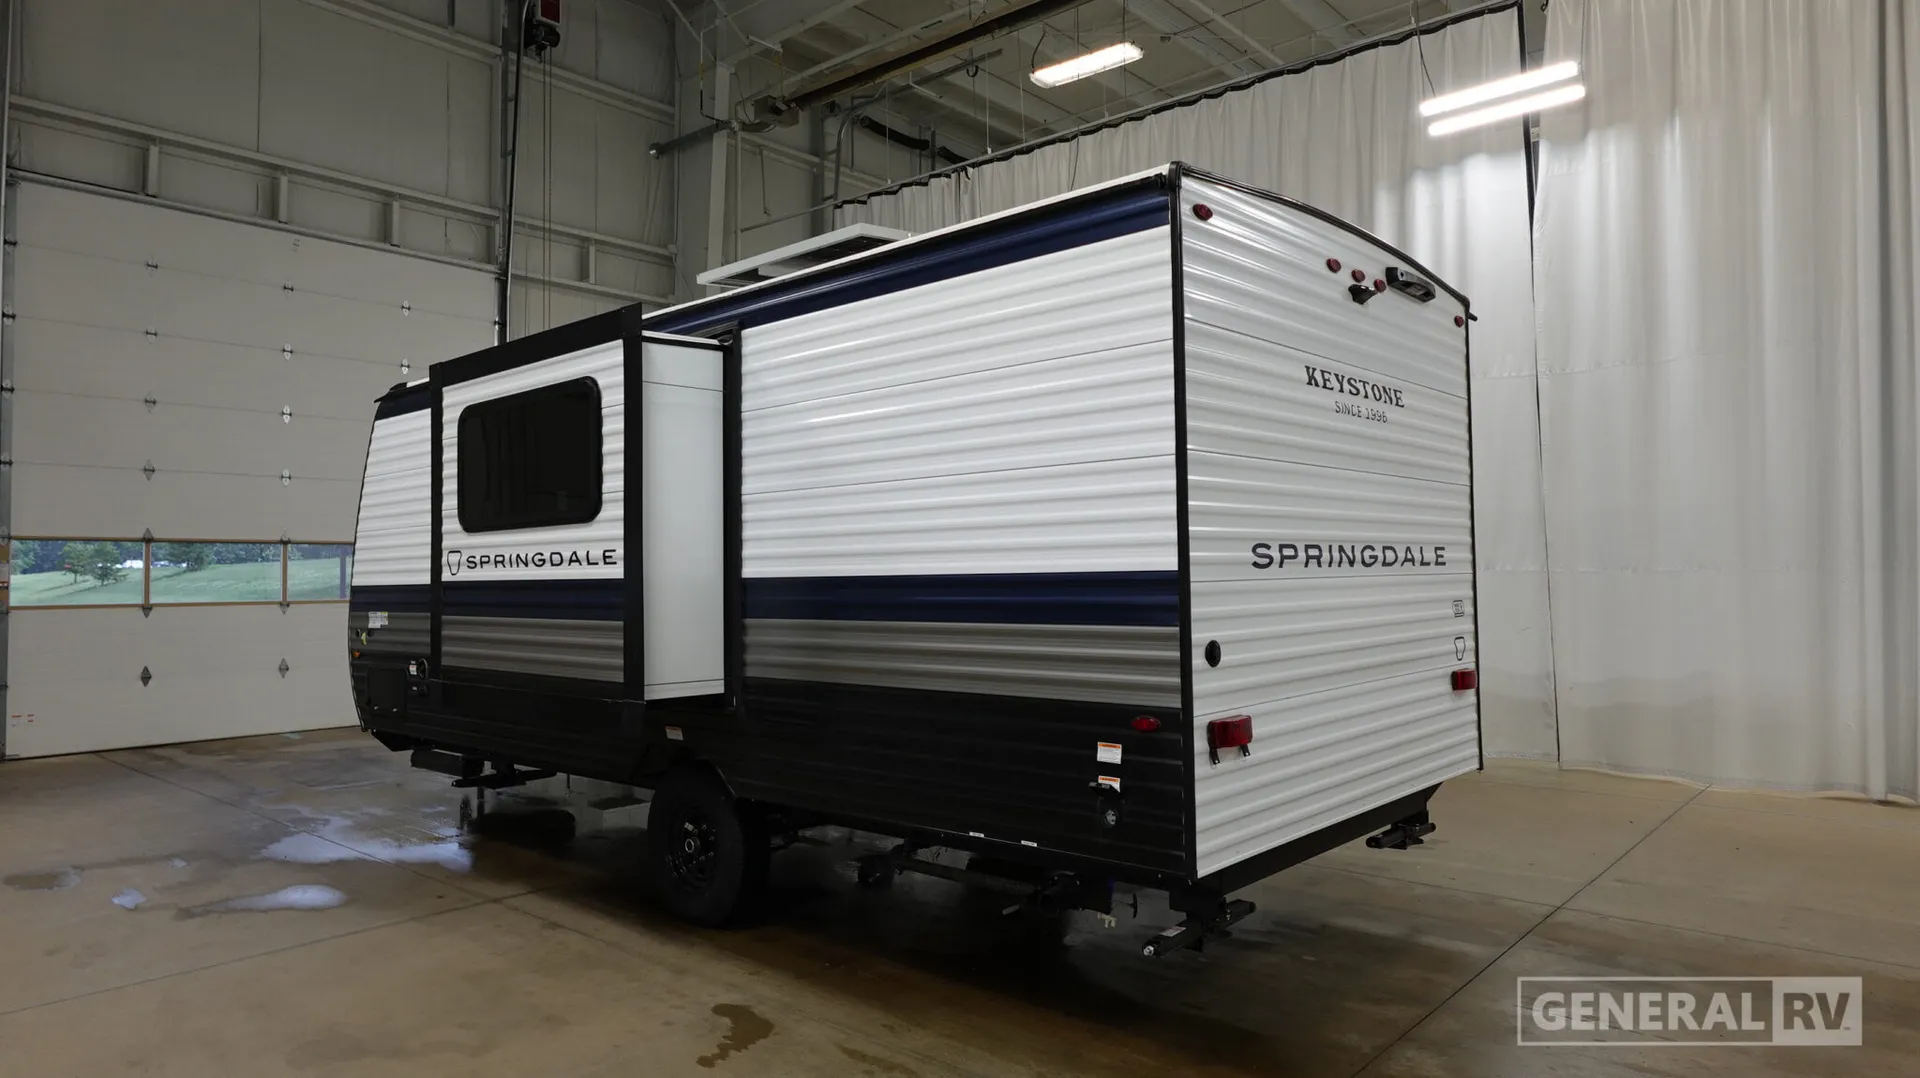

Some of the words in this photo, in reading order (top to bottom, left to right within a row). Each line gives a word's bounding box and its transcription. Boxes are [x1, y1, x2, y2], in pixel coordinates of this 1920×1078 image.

[1304, 365, 1405, 408] KEYSTONE
[1335, 401, 1362, 418] SINCE
[1365, 408, 1388, 423] 1996
[466, 549, 618, 570] SPRINGDALE
[1251, 543, 1447, 569] SPRINGDALE
